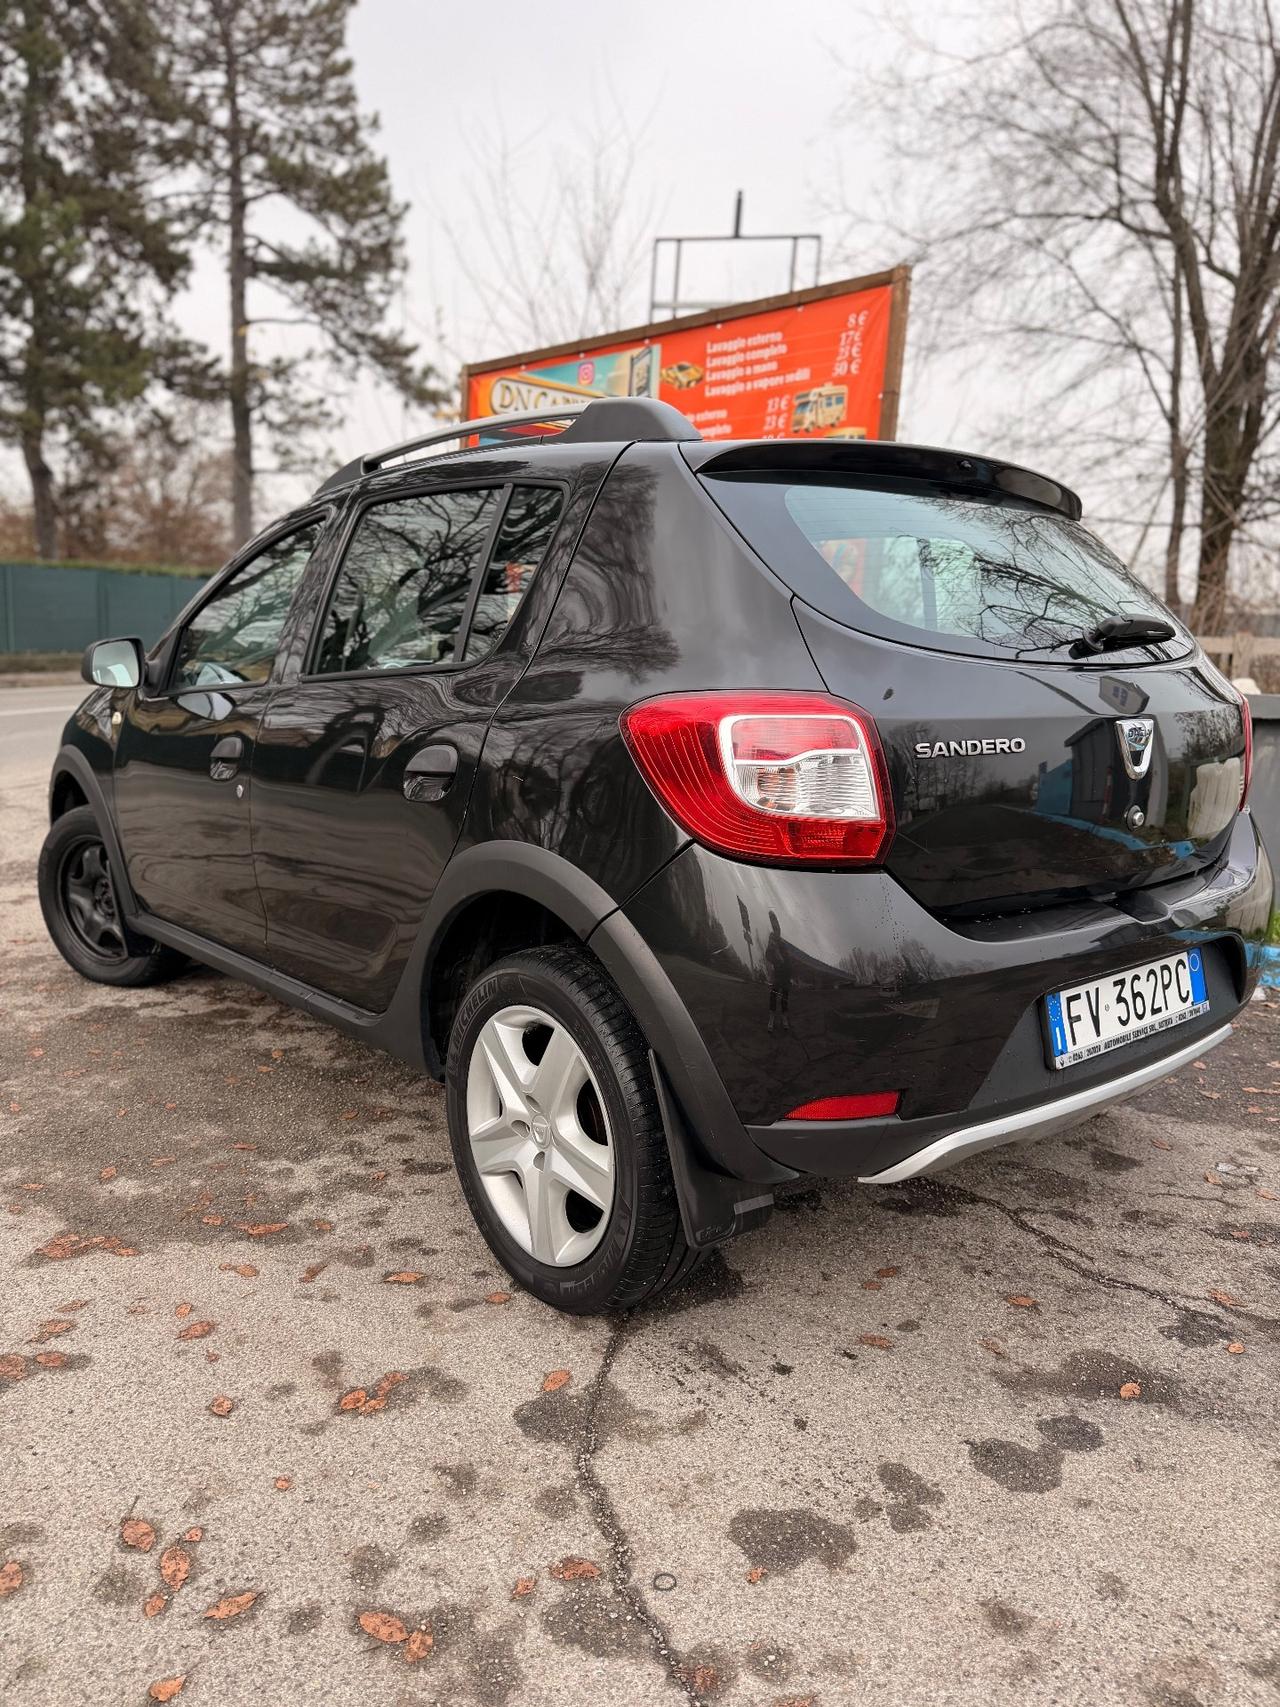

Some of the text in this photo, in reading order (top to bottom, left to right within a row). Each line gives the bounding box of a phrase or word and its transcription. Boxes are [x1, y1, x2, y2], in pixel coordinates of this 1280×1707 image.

[858, 310, 869, 325] €
[706, 331, 783, 353] Lavaggio esterno
[851, 342, 863, 357] €
[706, 344, 788, 368] Lavaggio completo
[850, 358, 862, 375] €
[705, 361, 778, 382] Lavaggio a mano
[704, 380, 745, 397] Lavaggio
[746, 381, 752, 391] a
[752, 375, 784, 391] vapore
[499, 384, 532, 411] DN
[780, 395, 790, 410] €
[777, 413, 788, 429] €
[914, 737, 1027, 760] SANDERO
[452, 977, 498, 1049] MICHELIN
[1066, 958, 1190, 1046] FV 362PC
